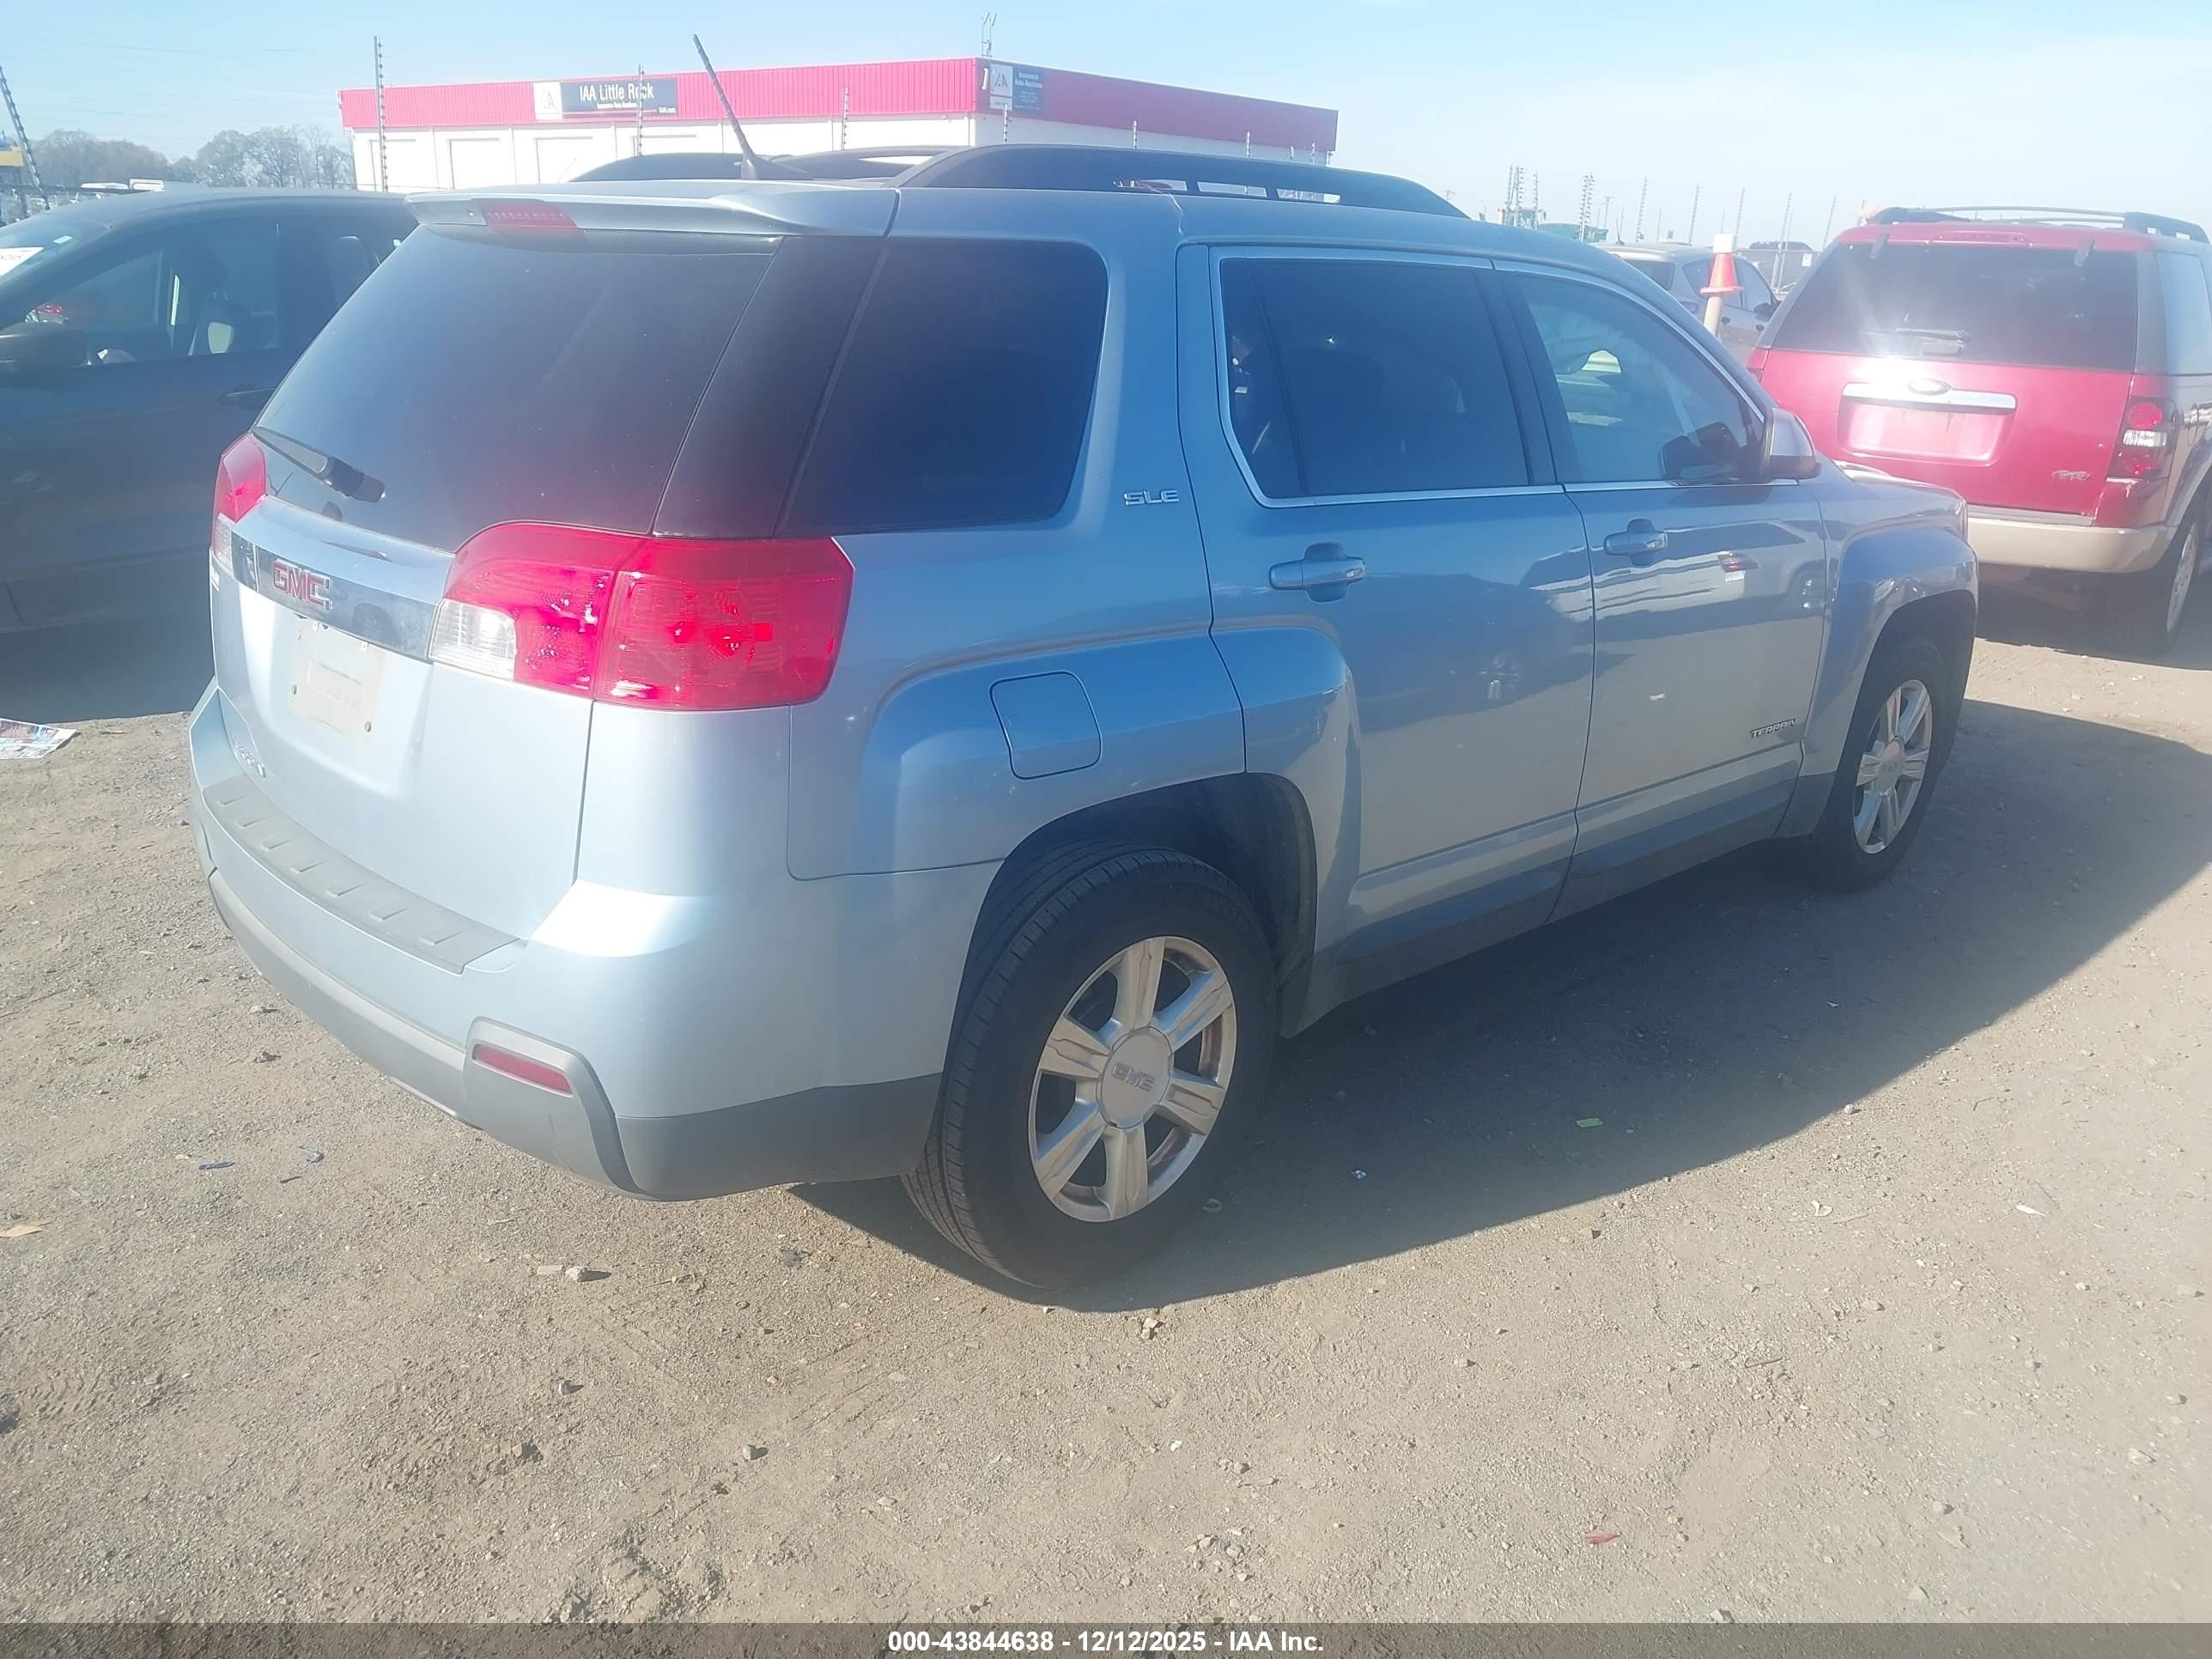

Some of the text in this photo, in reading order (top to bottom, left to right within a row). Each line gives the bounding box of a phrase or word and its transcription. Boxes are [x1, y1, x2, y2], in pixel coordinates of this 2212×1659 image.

[580, 85, 597, 101] IAA
[599, 84, 624, 100] Little
[1123, 490, 1180, 506] SLE
[272, 558, 332, 611] GMC
[1750, 718, 1798, 738] TERRAIN
[1112, 1061, 1155, 1092] GMC
